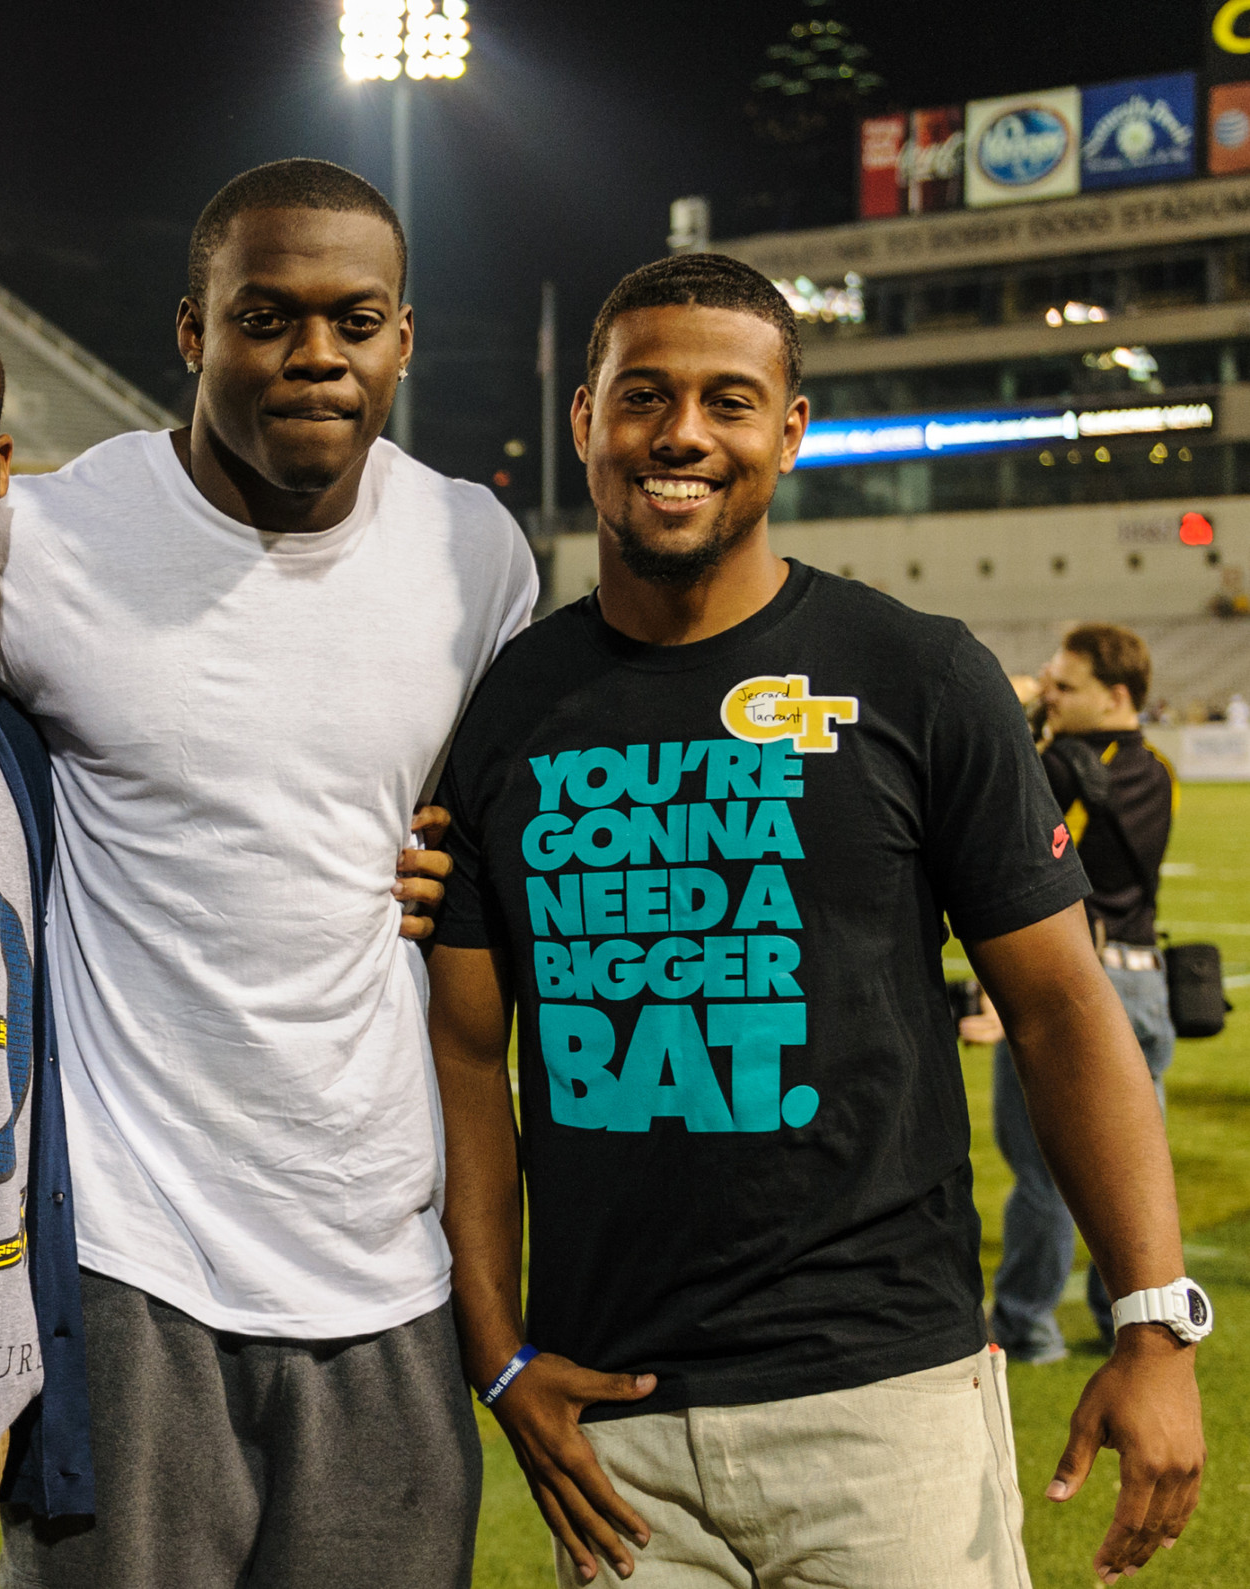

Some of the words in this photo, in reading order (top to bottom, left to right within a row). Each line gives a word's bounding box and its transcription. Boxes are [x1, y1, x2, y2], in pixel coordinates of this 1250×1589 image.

[736, 684, 790, 702] Jerrard
[743, 703, 802, 723] Tarrant
[528, 738, 805, 812] YOU'RE
[521, 800, 806, 871] GONNA
[525, 867, 729, 937] NEED
[731, 864, 804, 930] A
[533, 934, 805, 1001] BIGGER
[538, 1001, 820, 1133] BAT.
